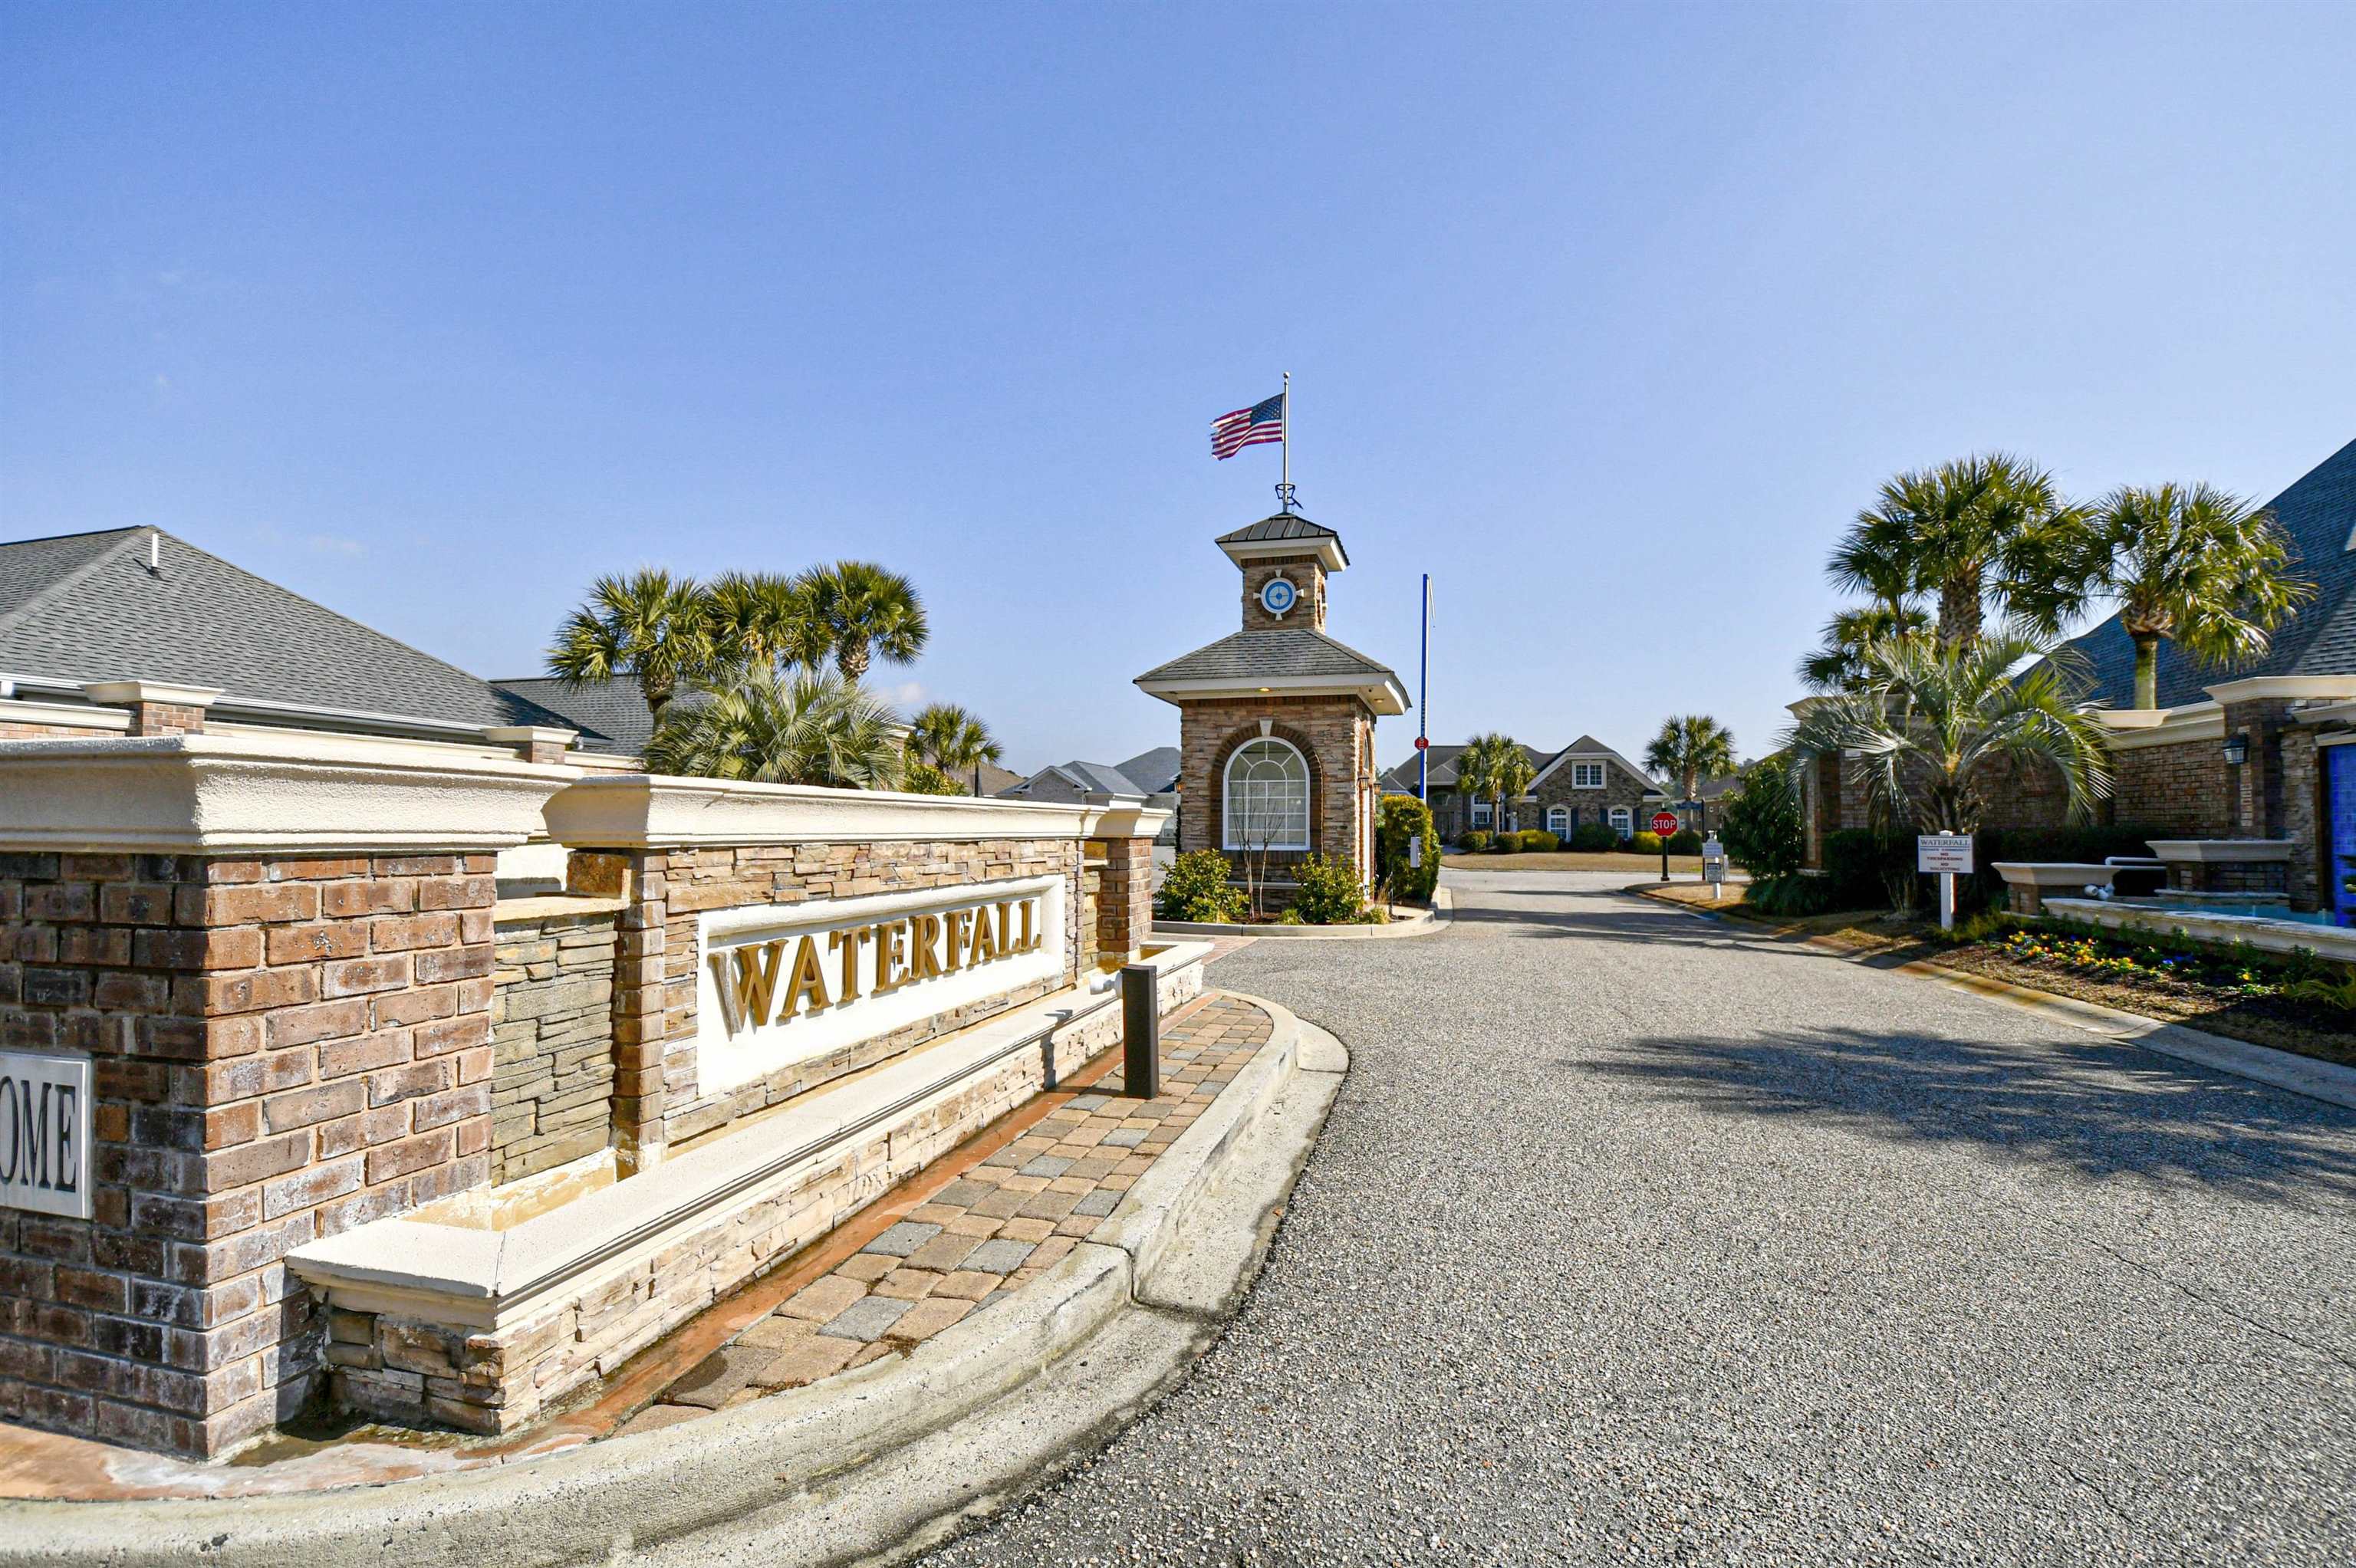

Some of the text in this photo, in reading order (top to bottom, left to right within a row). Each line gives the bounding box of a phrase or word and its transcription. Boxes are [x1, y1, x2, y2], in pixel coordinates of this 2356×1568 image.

[1653, 820, 1676, 829] STOP
[707, 899, 1041, 1034] WATERFALL
[0, 1076, 76, 1193] OME
